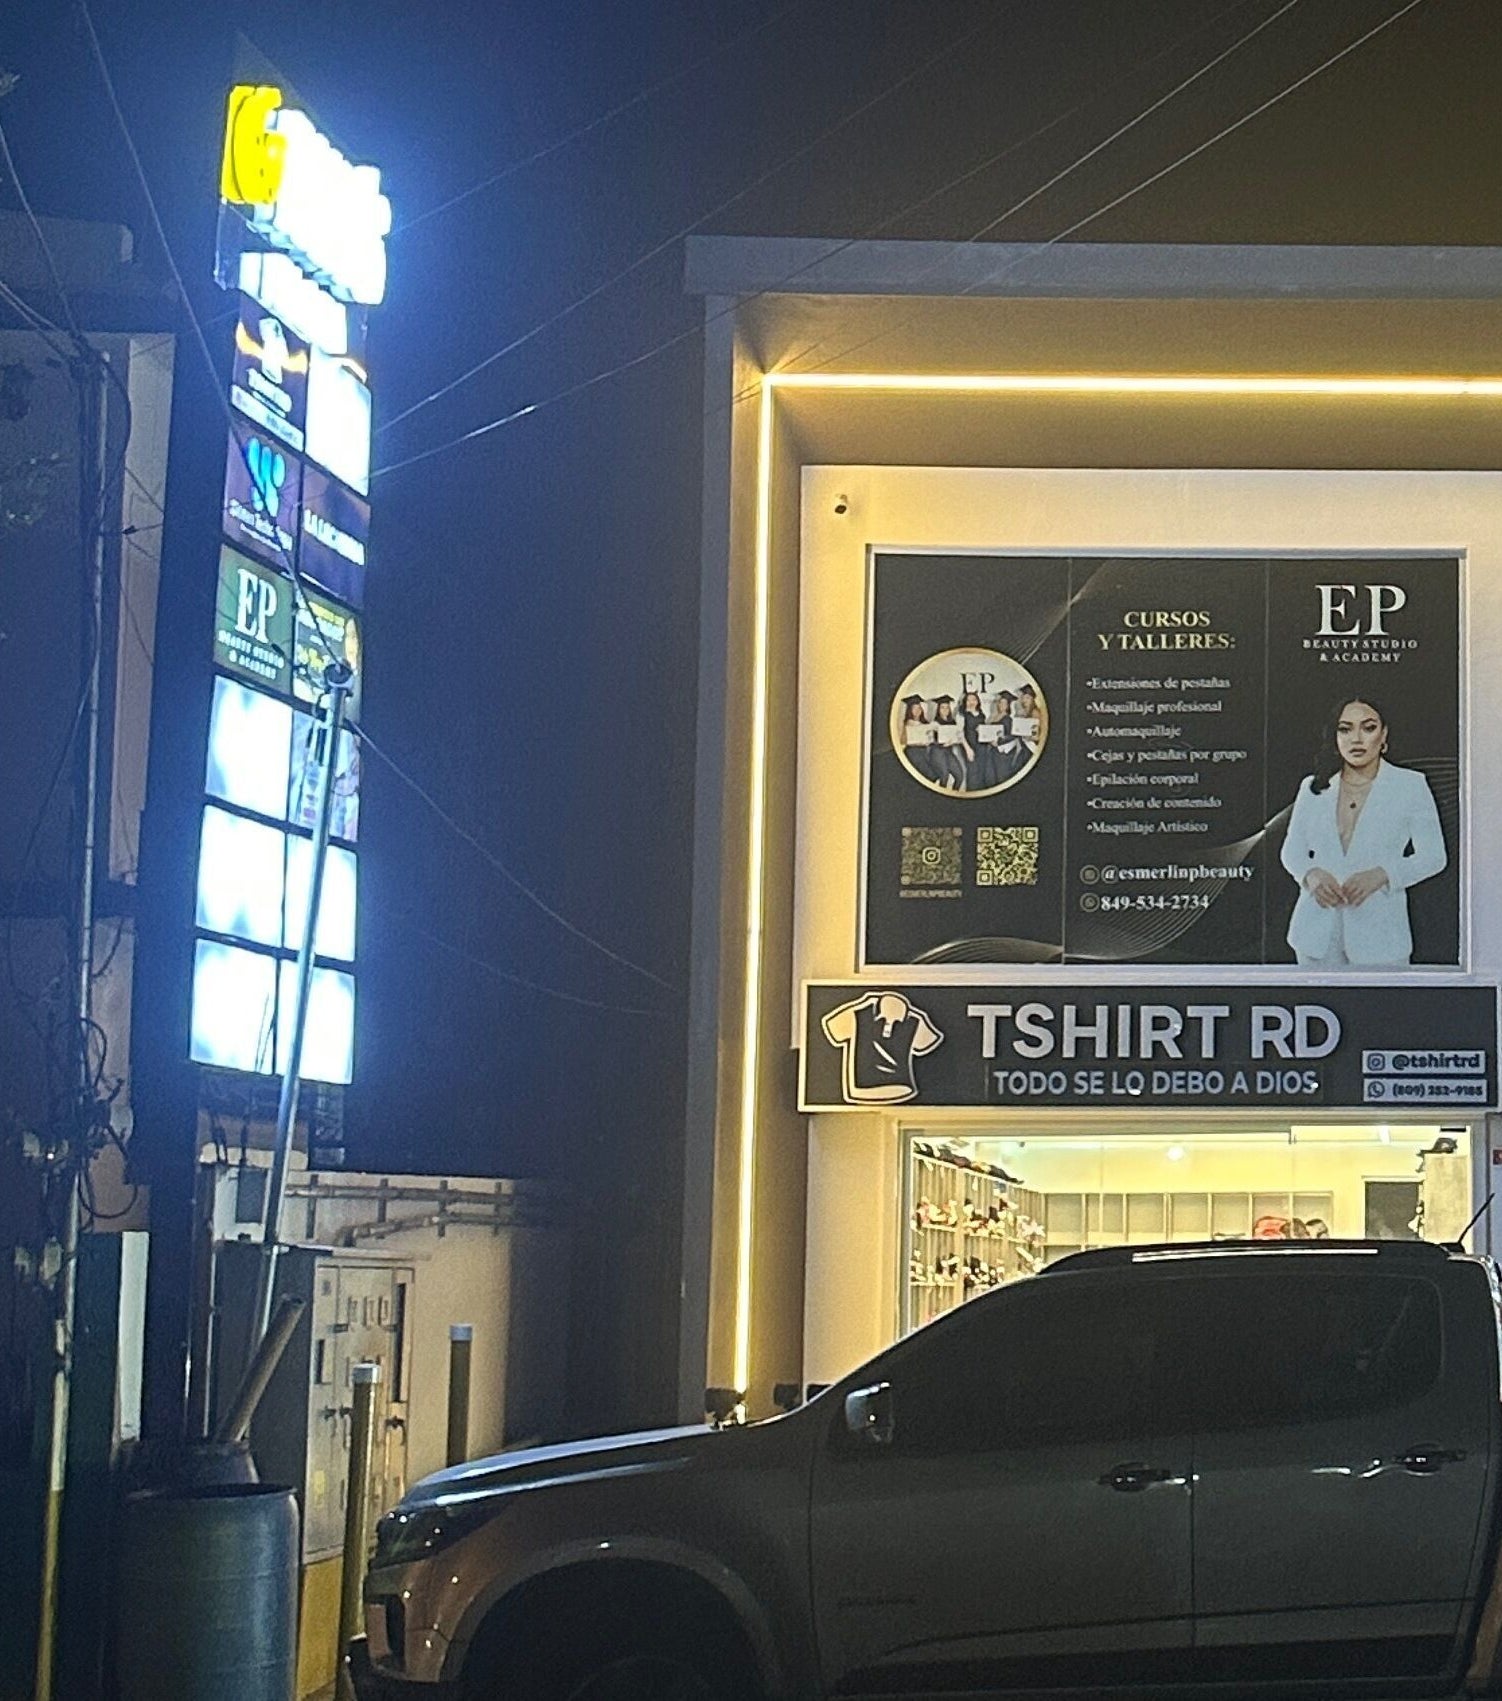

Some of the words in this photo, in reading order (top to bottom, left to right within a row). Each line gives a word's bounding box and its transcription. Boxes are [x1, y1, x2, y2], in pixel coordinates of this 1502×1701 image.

[235, 568, 278, 644] EP
[1315, 585, 1406, 635] EP
[1123, 610, 1211, 628] CURSOS
[1098, 633, 1114, 650] Y
[1117, 633, 1236, 650] TALLERES:
[1302, 639, 1359, 649] BEAUTY
[1362, 639, 1418, 649] STUDIO
[1332, 653, 1401, 662] ACADEMY
[1091, 677, 1161, 690] Extensiones
[1164, 677, 1179, 689] de
[1181, 676, 1231, 691] pestañas
[1091, 701, 1155, 716] Maquillaje
[1157, 700, 1222, 715] profesional
[1092, 725, 1181, 739] Automaquillaje
[1092, 750, 1124, 764] Cejas
[1126, 752, 1135, 763] y
[1137, 749, 1187, 763] pestañas
[1189, 752, 1210, 763] por
[1212, 751, 1248, 763] grupo
[1092, 773, 1148, 787] Epilación
[1150, 772, 1199, 786] corporal
[1092, 797, 1144, 809] Creación
[1147, 797, 1161, 809] de
[1164, 796, 1222, 809] contenido
[1091, 821, 1155, 835] Maquillaje
[1101, 895, 1210, 911] 849-534-2734
[967, 1002, 1230, 1059] TSHIRT
[1251, 1004, 1342, 1059] RD
[1392, 1053, 1480, 1071] @tshirtrd
[993, 1070, 1068, 1095] TODO
[1073, 1070, 1104, 1095] SE
[1111, 1070, 1145, 1096] LO
[1152, 1070, 1225, 1095] DEBO
[1230, 1070, 1250, 1095] A
[1256, 1070, 1318, 1095] DIOS
[1392, 1083, 1425, 1098] (809)
